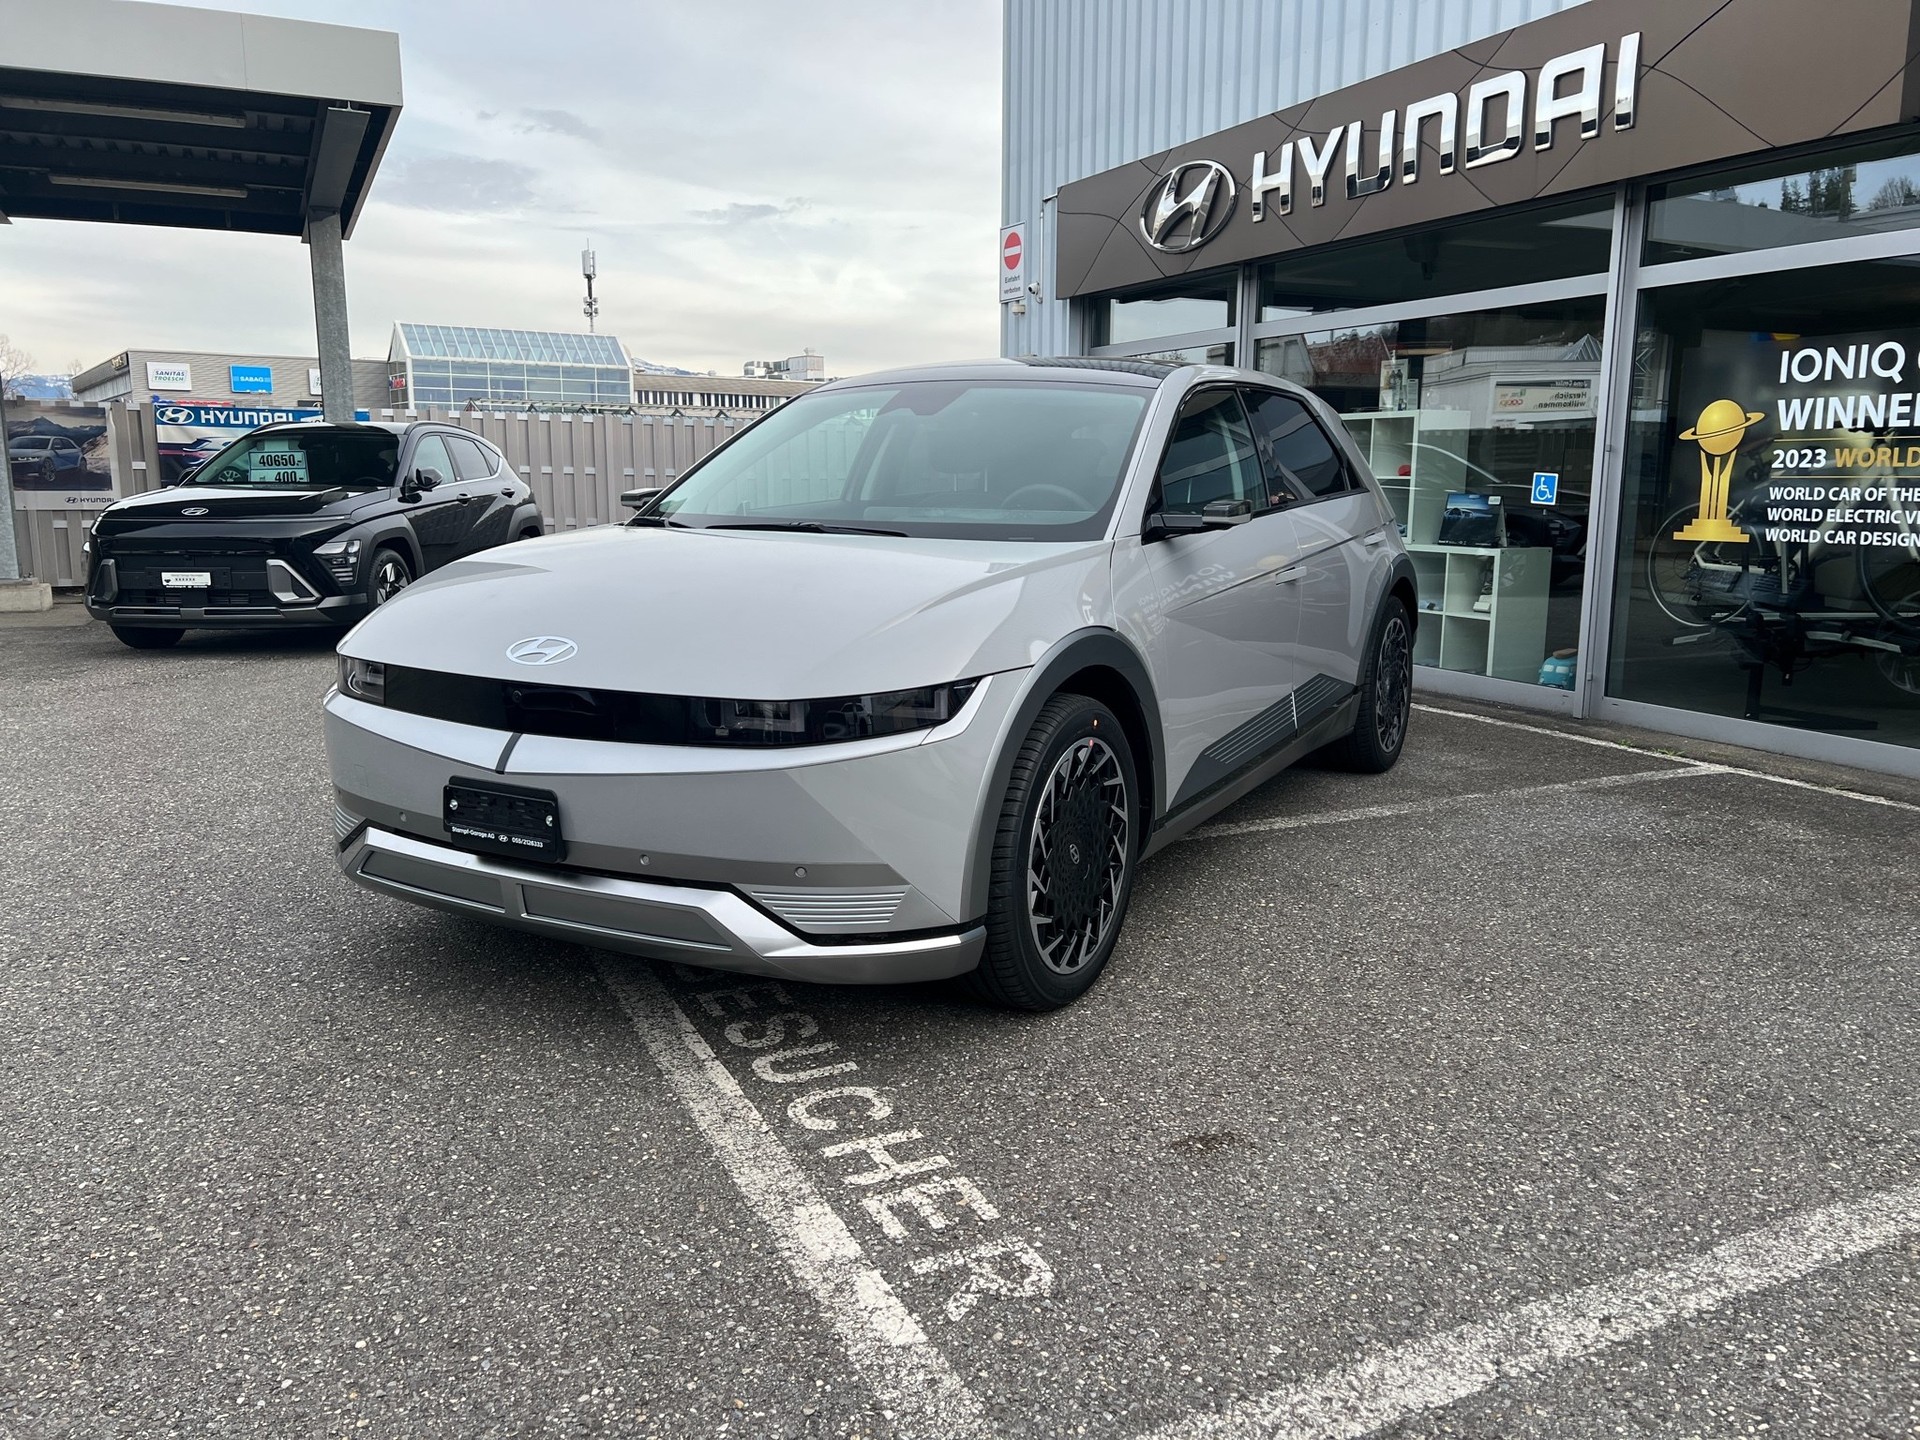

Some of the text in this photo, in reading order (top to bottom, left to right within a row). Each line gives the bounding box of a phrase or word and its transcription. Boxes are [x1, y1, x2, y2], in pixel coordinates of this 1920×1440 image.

[1252, 32, 1642, 223] HYUNDAI
[1779, 341, 1906, 385] IONIQ
[200, 409, 294, 424] HYUNDAI
[259, 454, 302, 467] 40650.-
[1771, 446, 1920, 469] 2023 WORLD
[1769, 487, 1920, 502] WORLD CAR OF THE
[1767, 508, 1824, 522] WORLD
[1826, 508, 1901, 524] ELECTRIC
[1765, 529, 1821, 543] WORLD
[1824, 530, 1857, 545] CAR
